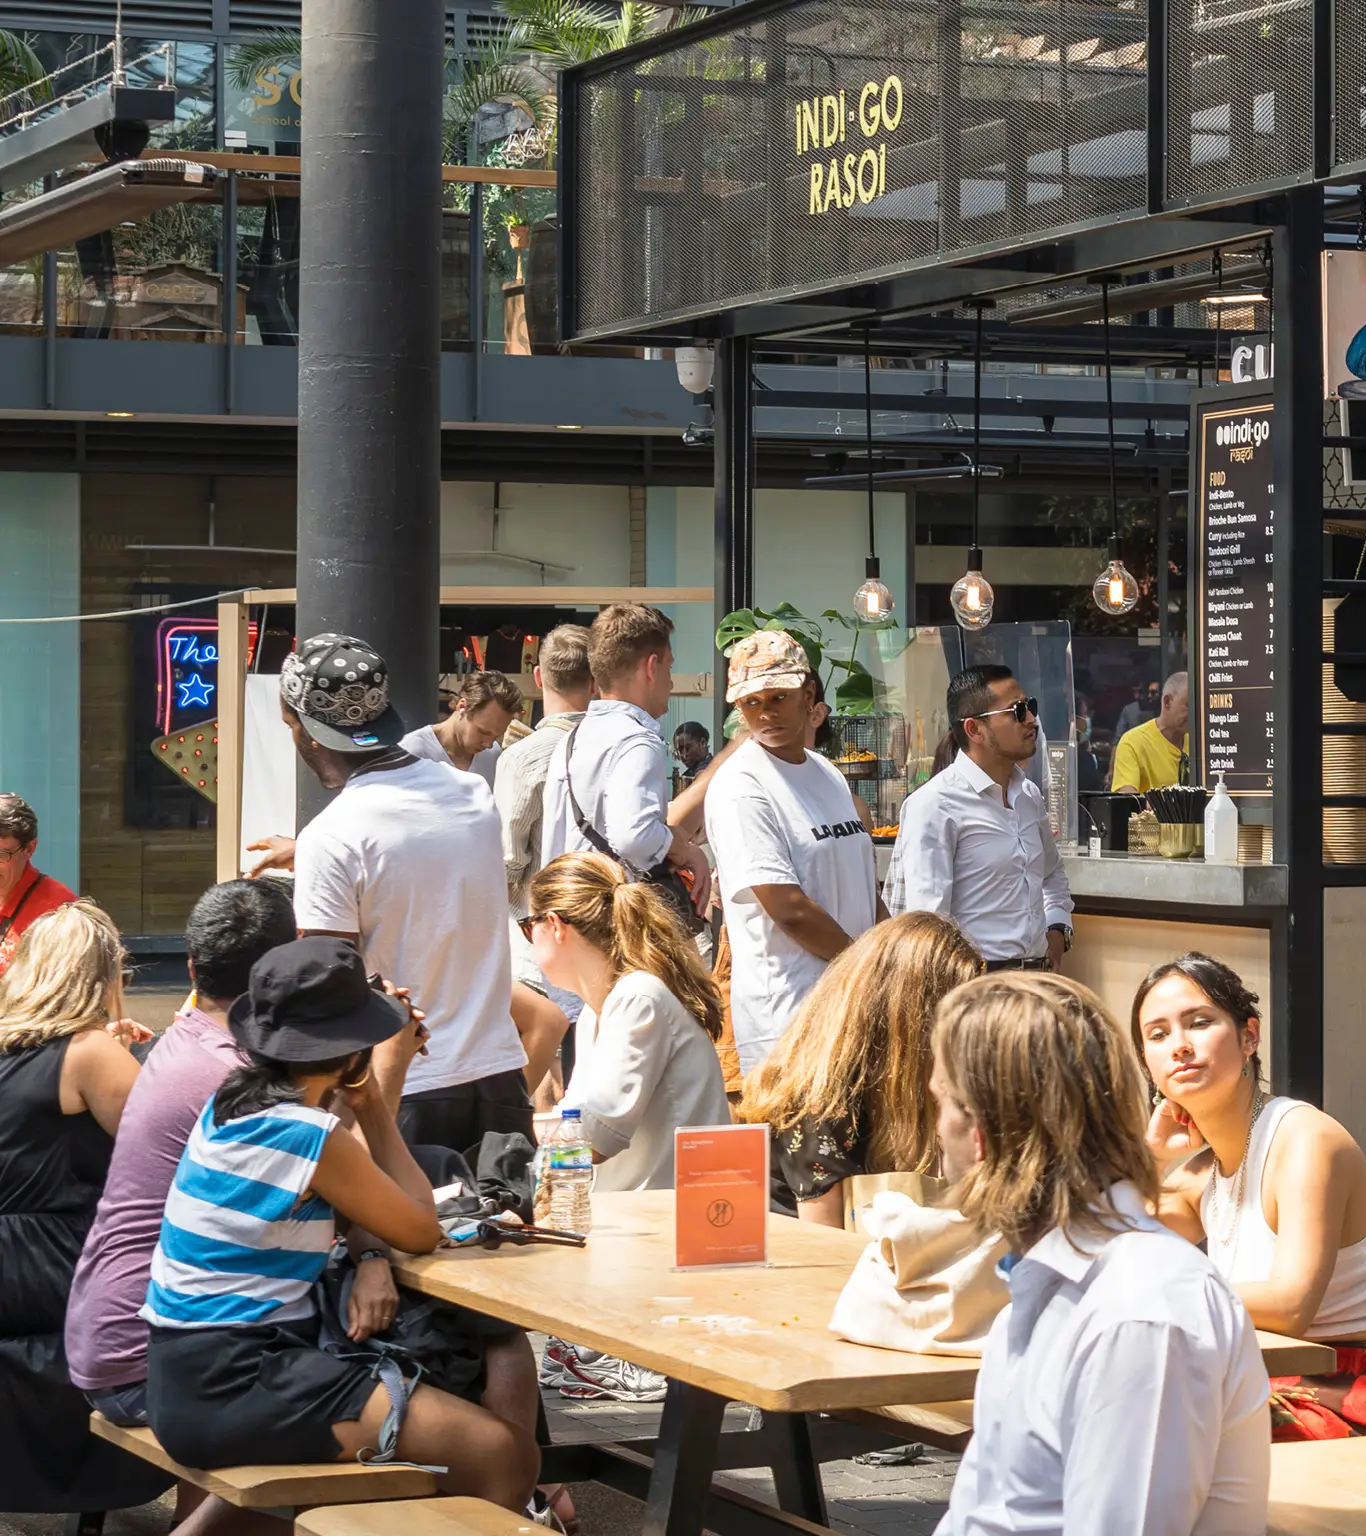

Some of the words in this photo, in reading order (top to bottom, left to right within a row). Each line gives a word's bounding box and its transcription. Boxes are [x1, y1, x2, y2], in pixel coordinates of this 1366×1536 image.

[809, 144, 886, 215] RASOI
[1210, 471, 1226, 487] FOOD
[1208, 515, 1226, 526] Brioche
[1227, 514, 1237, 524] Bun
[1237, 513, 1257, 523] Samosa
[1208, 531, 1222, 542] Curry
[1208, 545, 1230, 556] Tandoori
[1230, 544, 1241, 554] Grill
[1208, 601, 1225, 613] Biryani
[1208, 616, 1226, 627] Masala
[1226, 616, 1239, 626] Dosa
[1208, 633, 1227, 642] Samosa
[1227, 631, 1242, 641] Chaat
[168, 635, 219, 662] The
[1219, 646, 1229, 657] Roll
[1208, 673, 1221, 683] Chilli
[1221, 672, 1233, 682] Fries
[1209, 693, 1233, 708] DRINKS
[1209, 713, 1226, 725] Mango
[1227, 713, 1239, 723] Lassi
[1209, 728, 1221, 738] Chai
[1221, 729, 1230, 738] tea
[1209, 744, 1226, 753] Nimbu
[1226, 743, 1238, 755] pani
[1210, 758, 1221, 769] Soft
[1221, 758, 1235, 768] Drink
